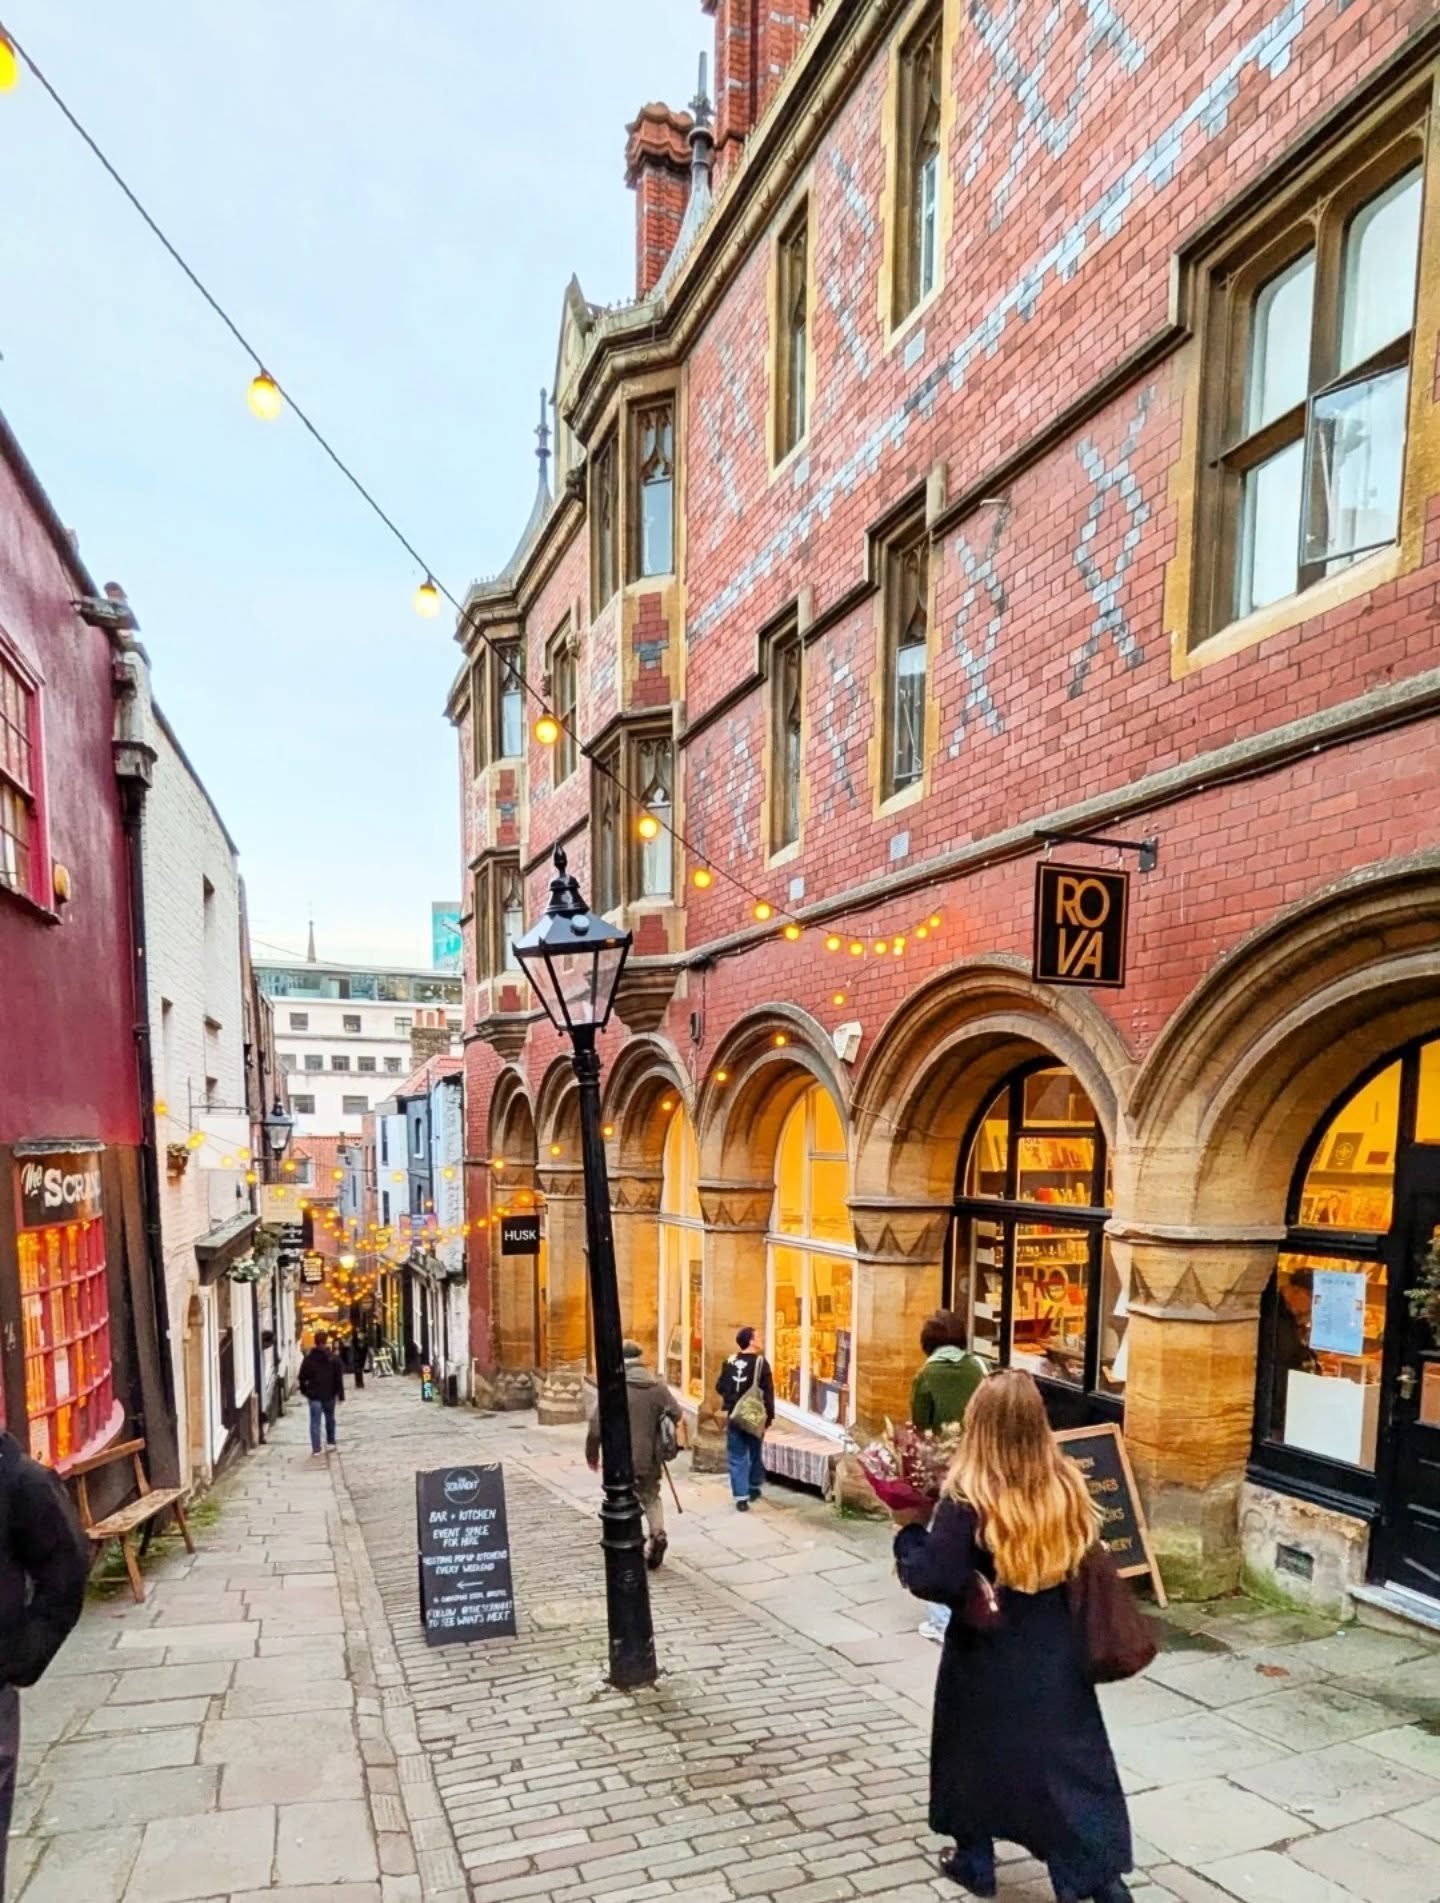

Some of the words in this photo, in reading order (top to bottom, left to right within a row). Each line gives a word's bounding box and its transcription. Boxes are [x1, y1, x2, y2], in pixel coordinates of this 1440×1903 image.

[504, 1229, 537, 1241] HUSK
[429, 1511, 448, 1523] BAR
[459, 1508, 496, 1521] KITCHEN
[433, 1527, 461, 1539] EVENT
[465, 1524, 490, 1536] SPACE
[443, 1538, 459, 1548] FOR
[461, 1536, 479, 1547] HIRE
[435, 1565, 460, 1575] EVERY
[462, 1562, 495, 1572] WEEKEND
[426, 1608, 457, 1619] FOLLOW
[428, 1619, 439, 1629] TO
[441, 1617, 455, 1627] SEE
[487, 1611, 511, 1622] NEXT
